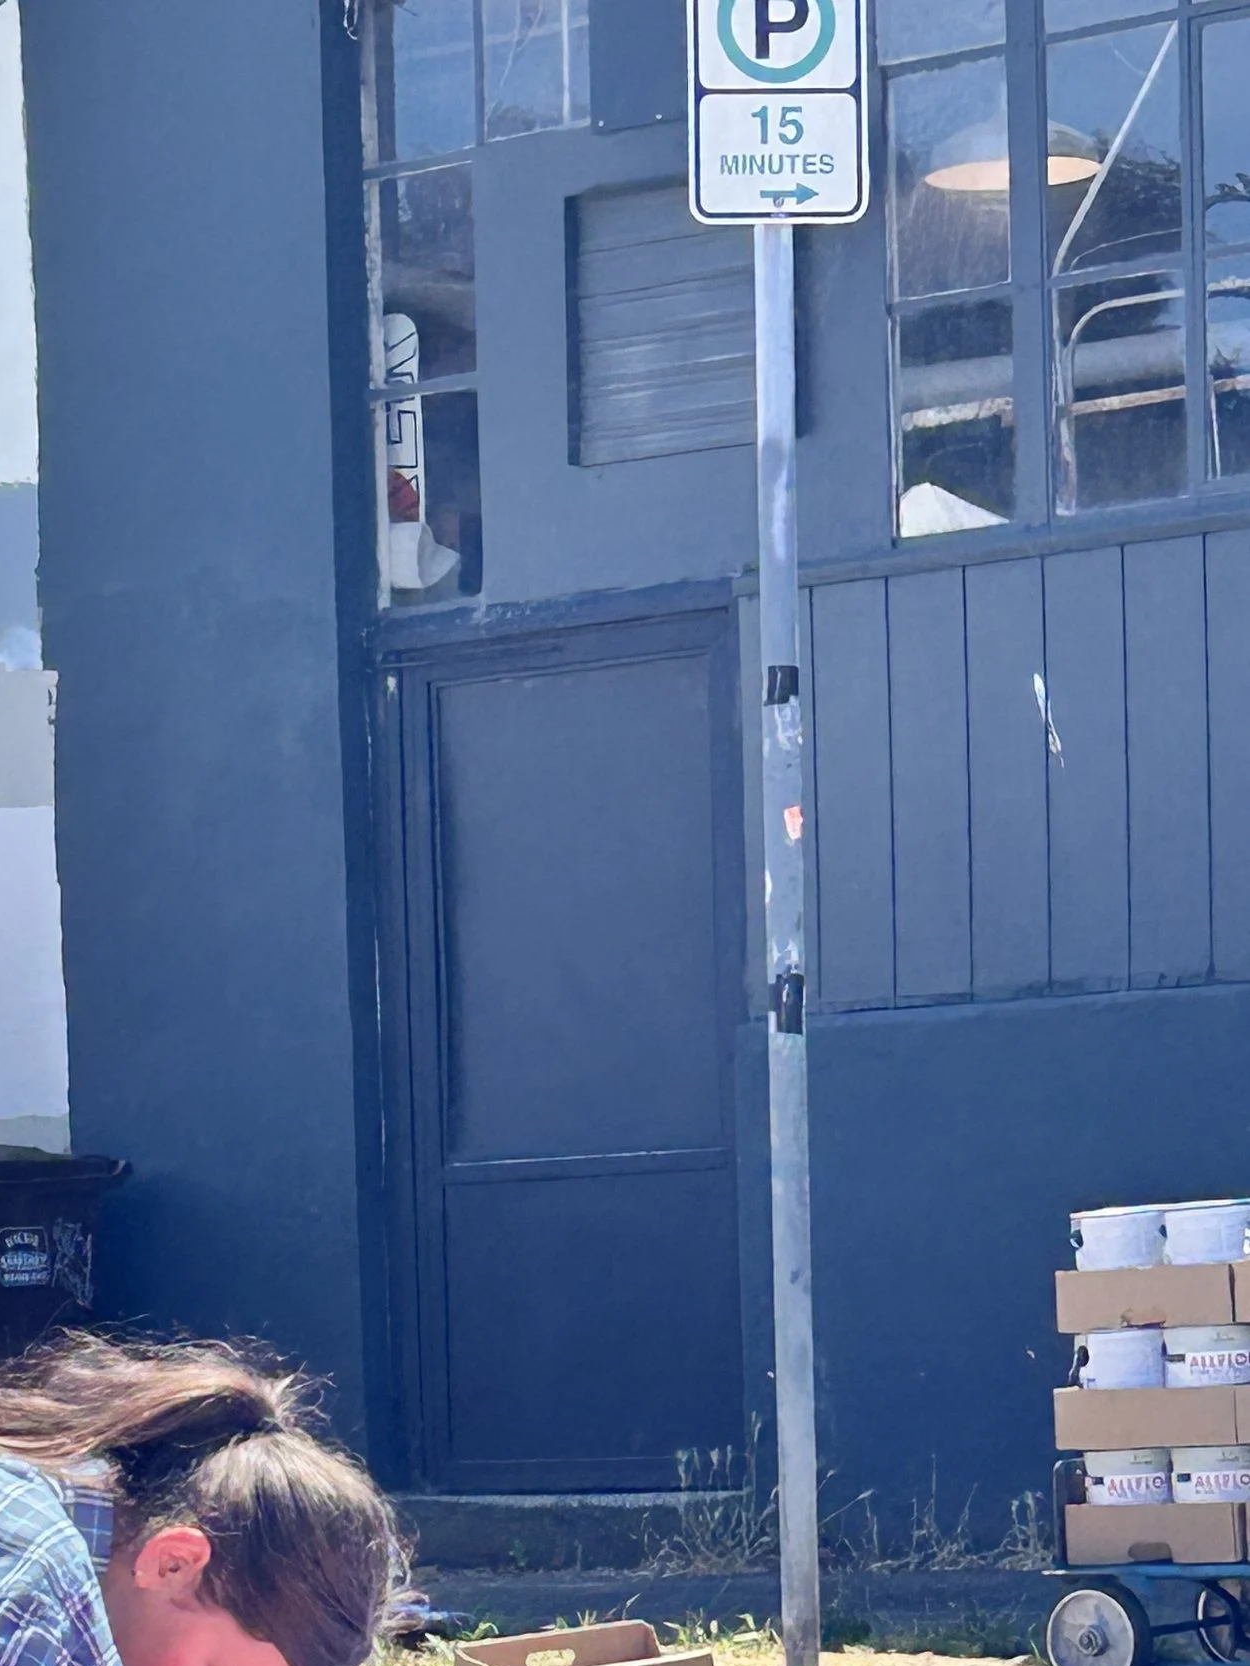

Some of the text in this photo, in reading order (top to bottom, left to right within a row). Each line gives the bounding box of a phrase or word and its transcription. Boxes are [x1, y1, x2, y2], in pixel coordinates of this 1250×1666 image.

[755, 0, 810, 60] P
[750, 105, 805, 145] 15
[720, 153, 835, 176] MINUTES
